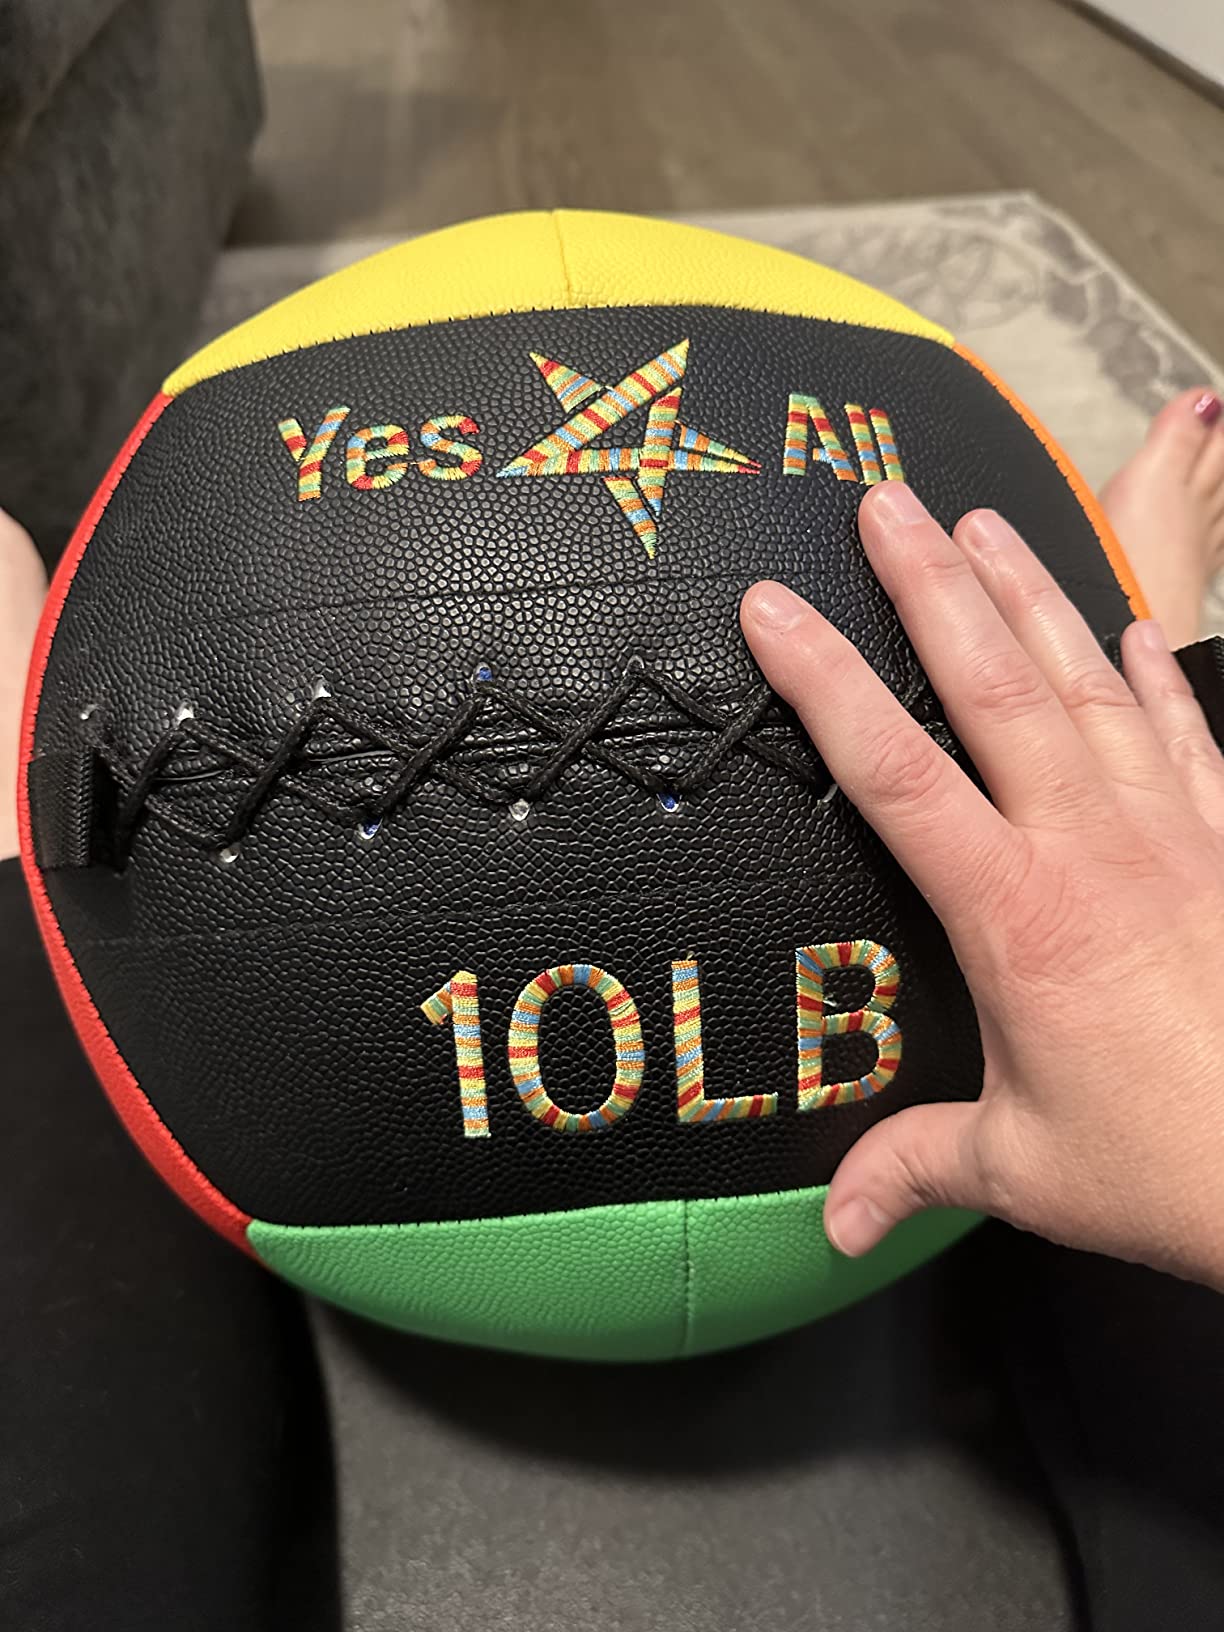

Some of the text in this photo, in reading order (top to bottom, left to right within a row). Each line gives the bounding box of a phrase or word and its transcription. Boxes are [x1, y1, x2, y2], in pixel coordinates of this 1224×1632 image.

[278, 406, 483, 501] Yes
[783, 392, 905, 486] All
[420, 939, 903, 1138] 10LB
